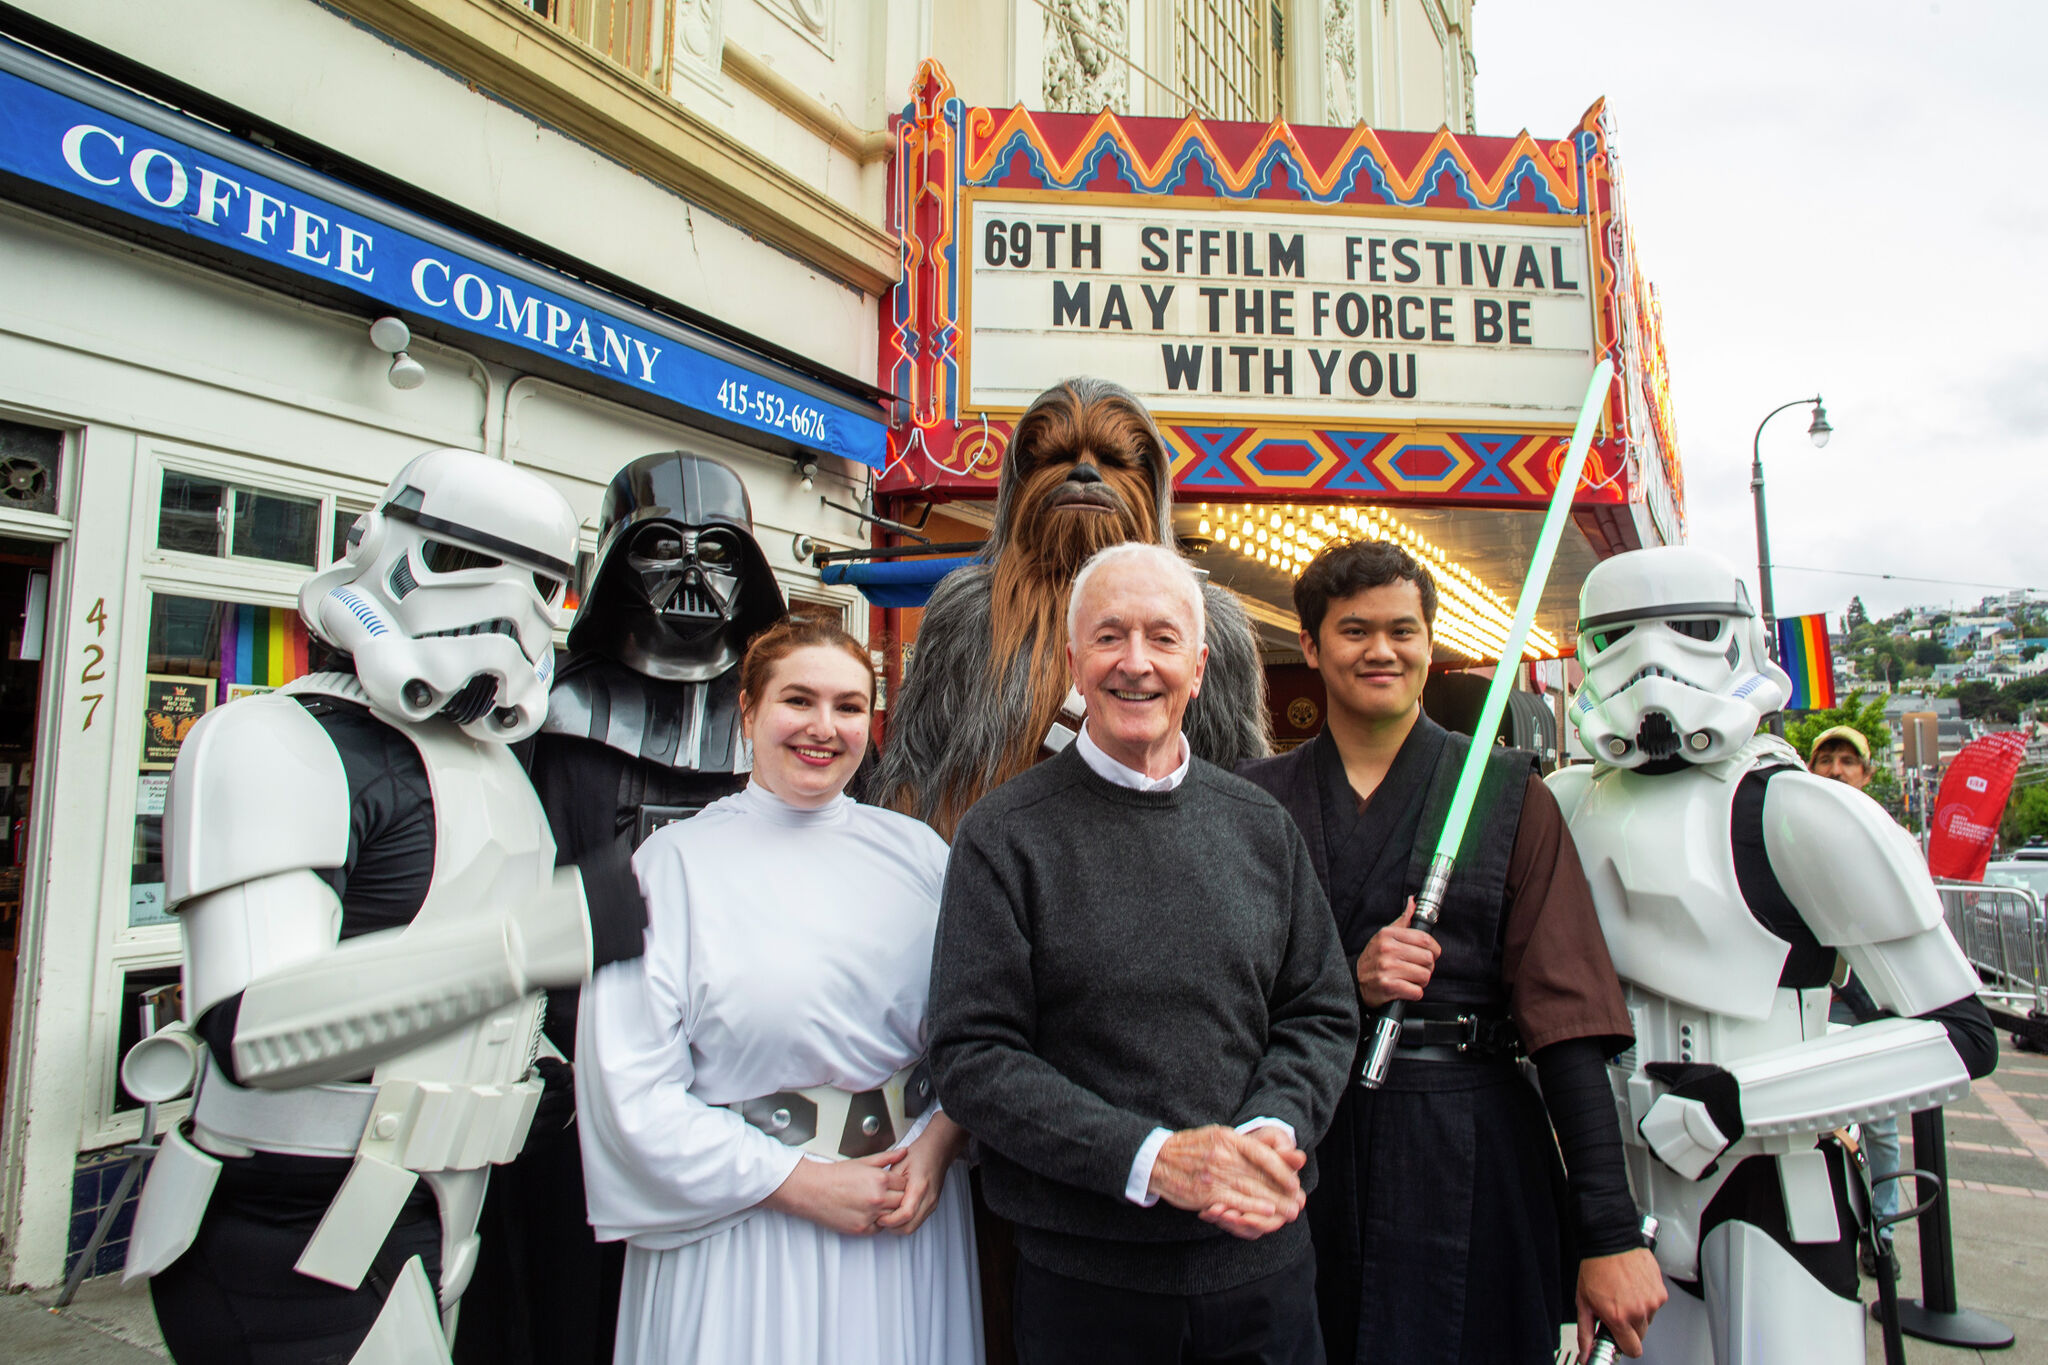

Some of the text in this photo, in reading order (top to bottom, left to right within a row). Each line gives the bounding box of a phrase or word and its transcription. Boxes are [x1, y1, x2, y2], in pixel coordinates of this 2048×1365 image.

[62, 124, 662, 384] COFFEE COMPANY
[985, 219, 1579, 290] 69TH SFFILM FESTIVAL
[1053, 280, 1533, 345] MAY THE FORCE BE
[1161, 344, 1417, 399] WITH YOU
[717, 378, 826, 441] 415-552-6676
[80, 597, 109, 732] 427
